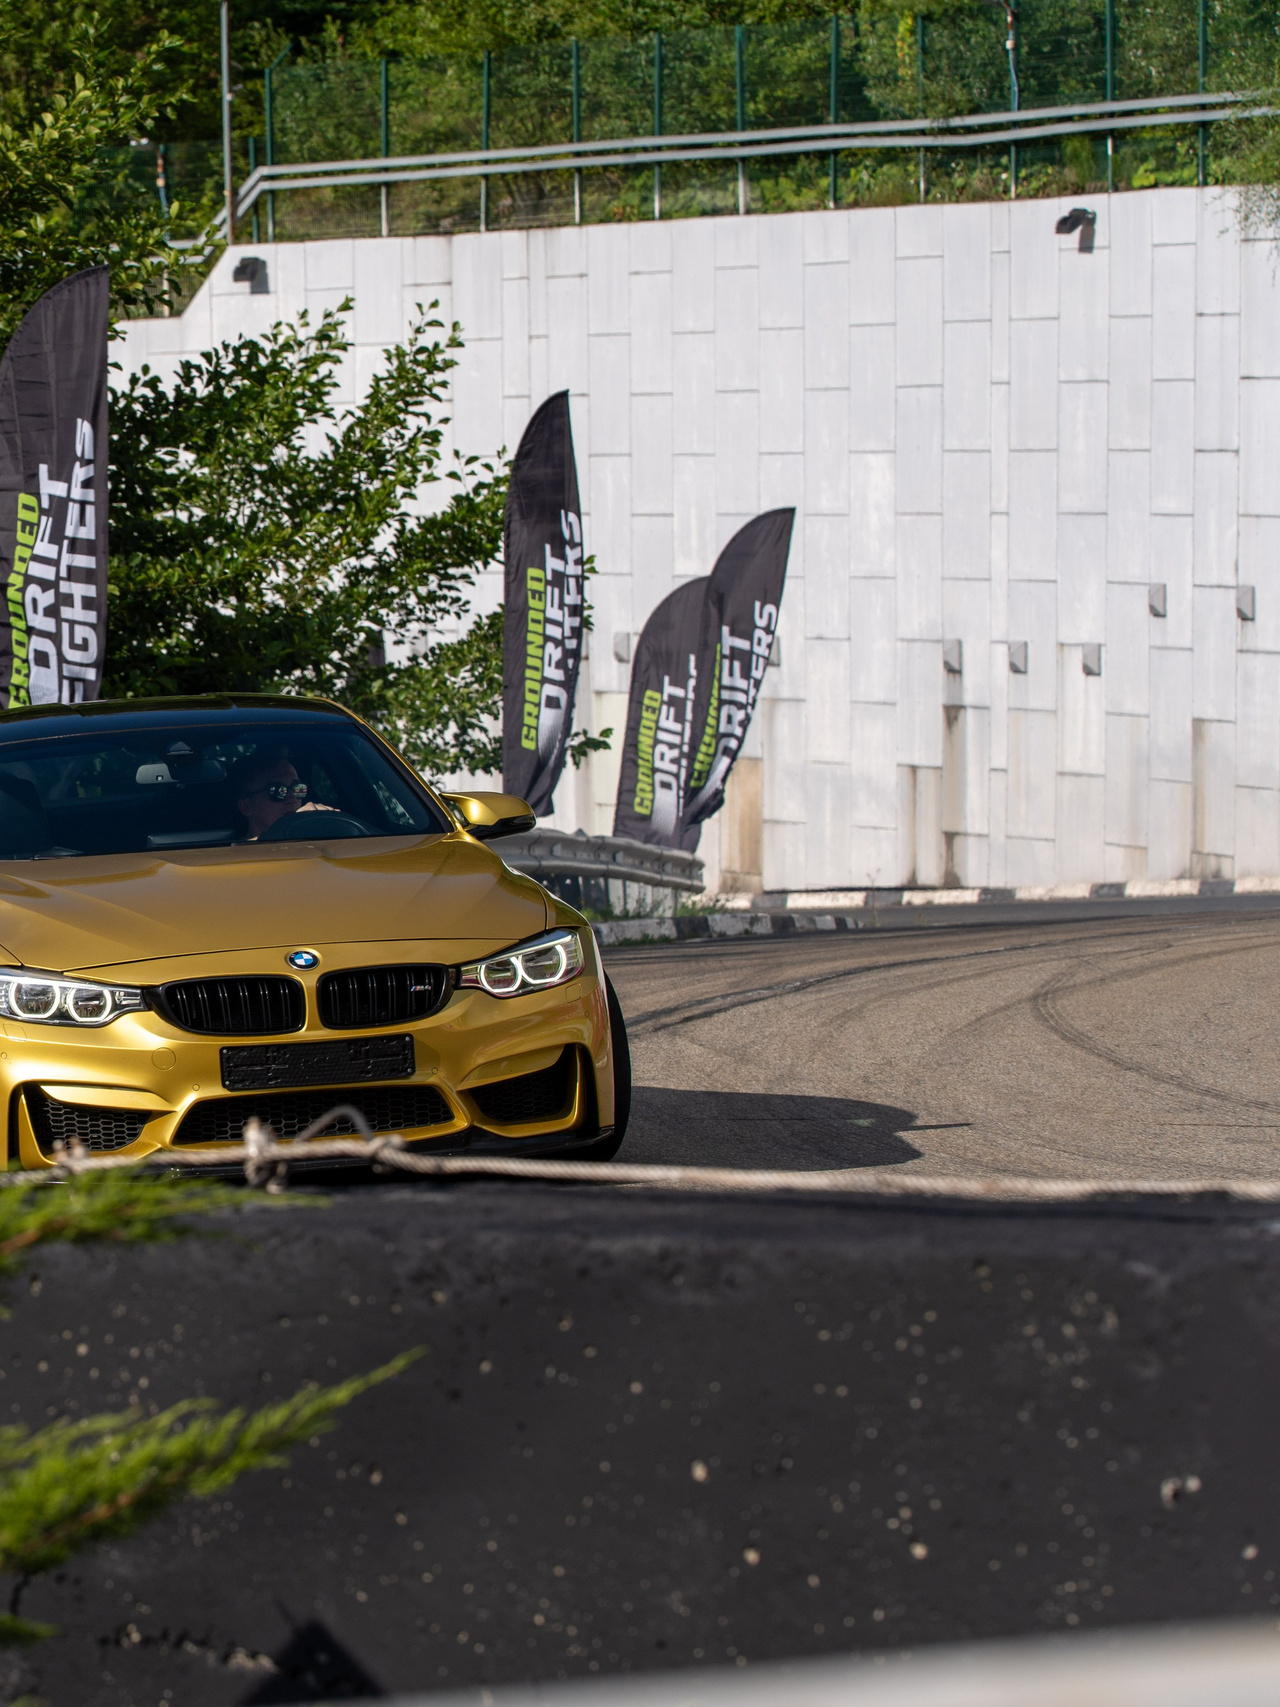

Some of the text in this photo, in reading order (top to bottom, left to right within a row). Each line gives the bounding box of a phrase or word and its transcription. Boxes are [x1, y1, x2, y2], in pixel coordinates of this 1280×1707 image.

[7, 492, 40, 708] GROUNDED
[28, 463, 69, 706] DRIFT
[521, 566, 546, 750] GROUNDED
[538, 543, 568, 765] DRIFT
[634, 689, 662, 816] GROUNDED
[651, 675, 687, 836] DRIFT
